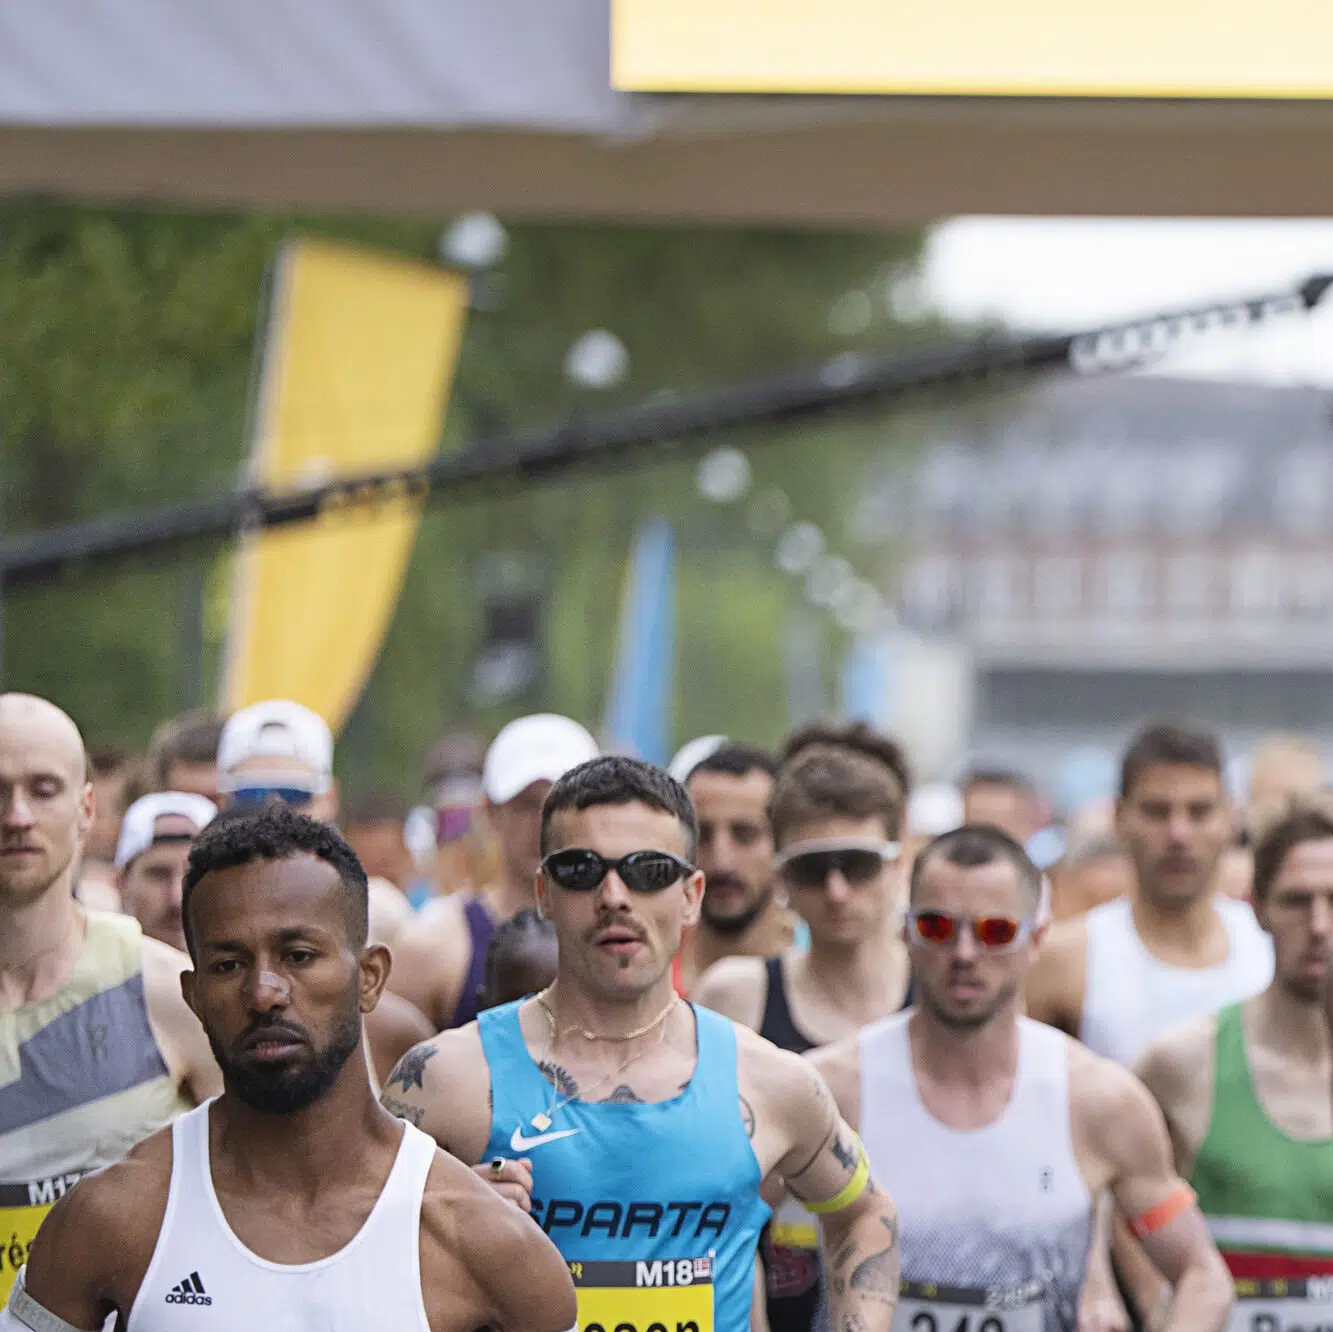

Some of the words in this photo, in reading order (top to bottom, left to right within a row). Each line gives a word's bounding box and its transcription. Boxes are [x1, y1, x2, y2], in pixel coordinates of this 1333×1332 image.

[0, 1231, 33, 1271] ré
[636, 1259, 694, 1287] M18
[165, 1292, 212, 1306] adidas
